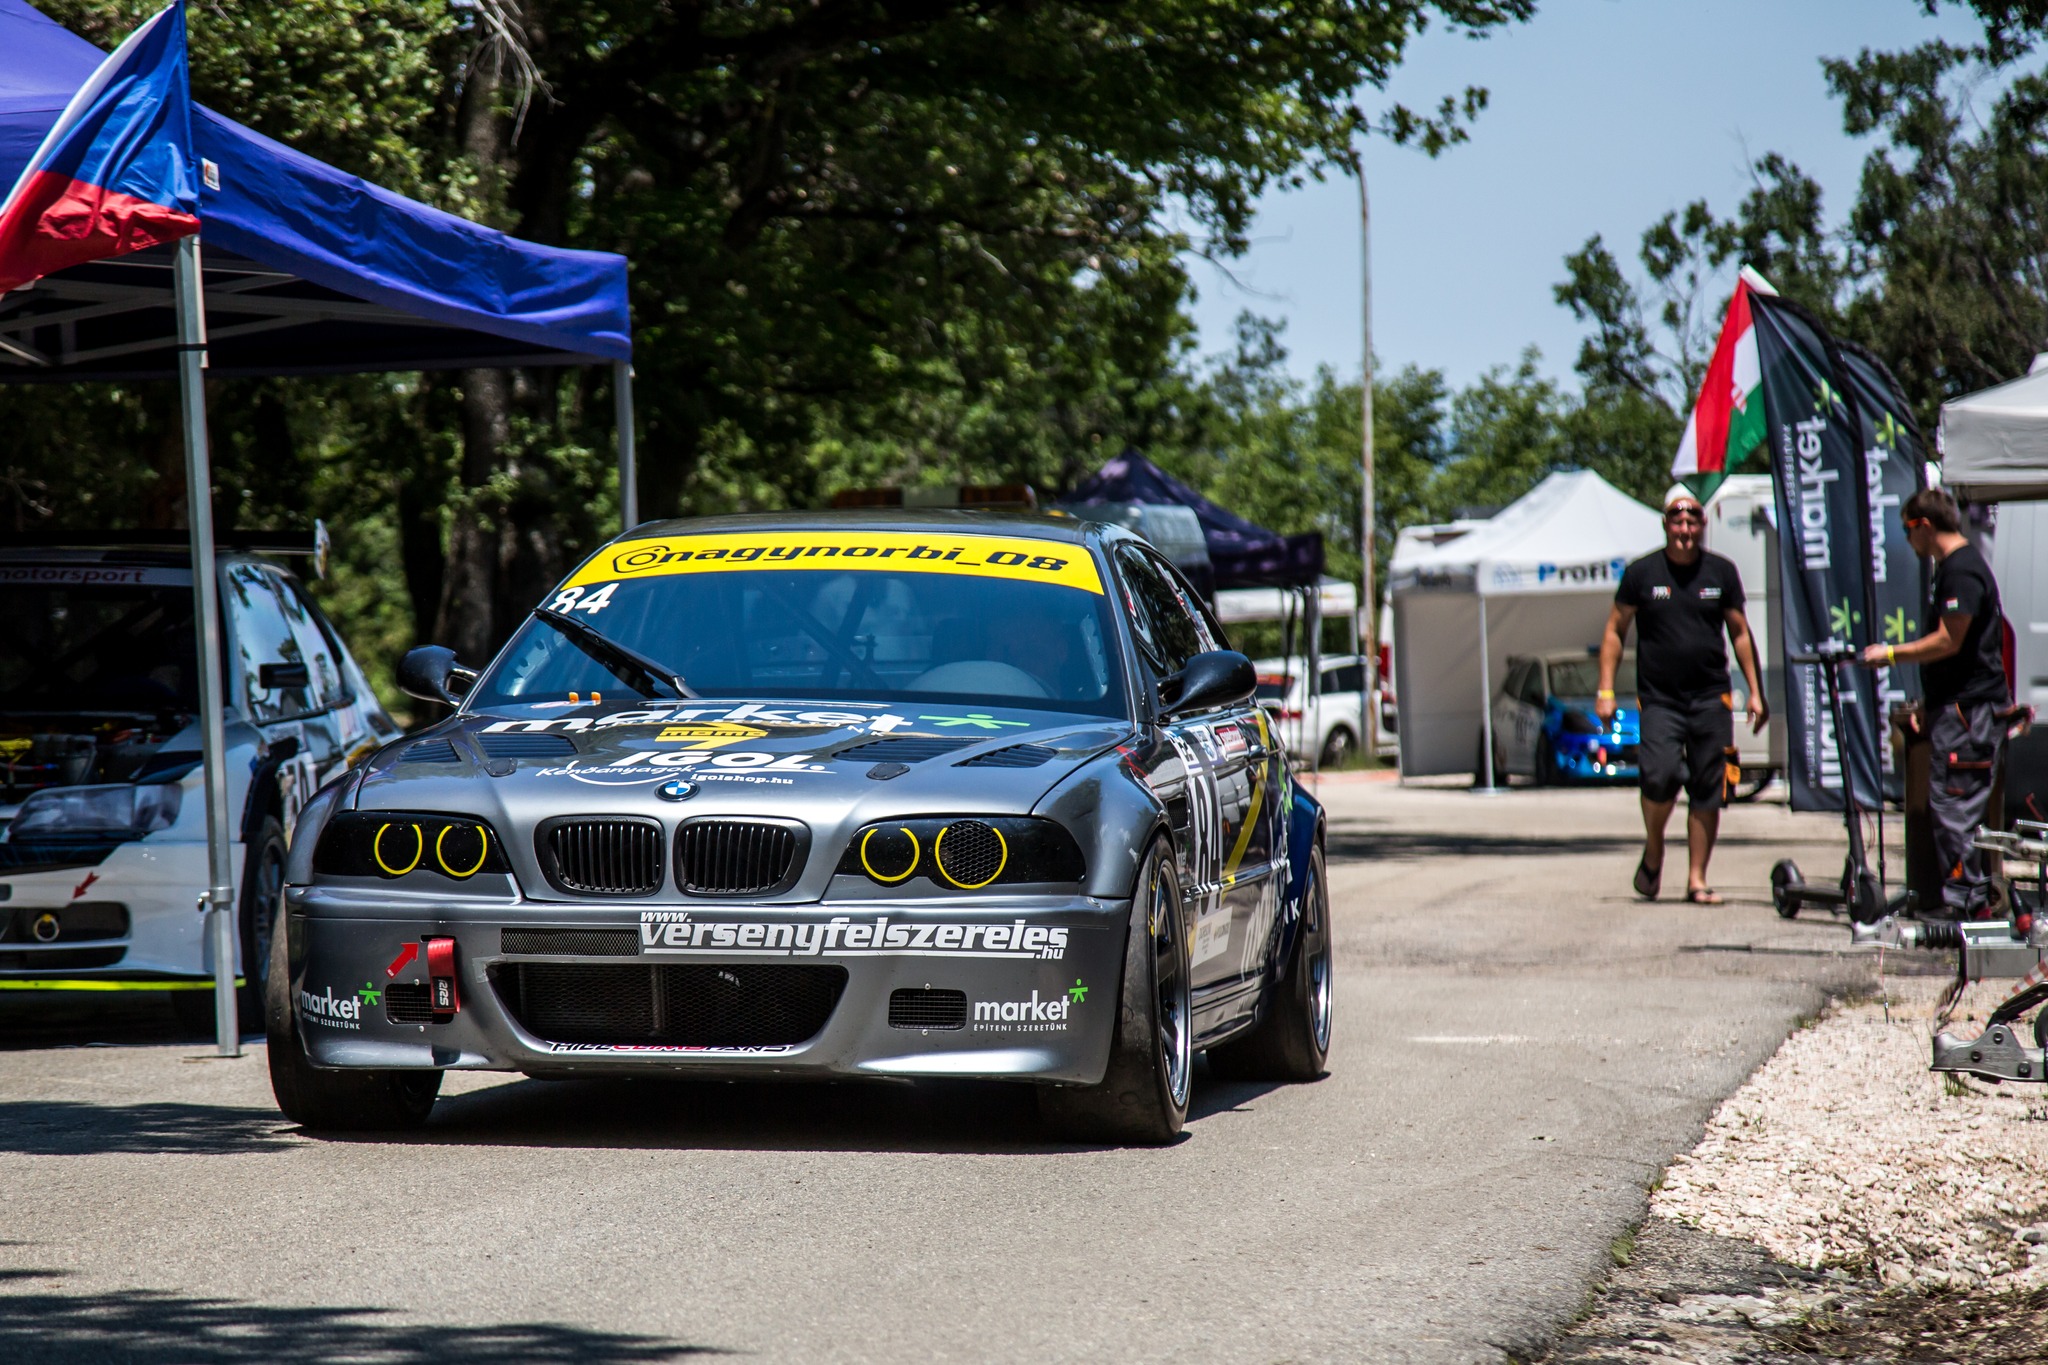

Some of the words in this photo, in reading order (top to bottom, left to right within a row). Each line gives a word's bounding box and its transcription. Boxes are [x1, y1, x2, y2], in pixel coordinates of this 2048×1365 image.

[546, 582, 620, 614] 84
[482, 704, 914, 733] market
[301, 985, 361, 1020] market
[974, 989, 1070, 1022] market
